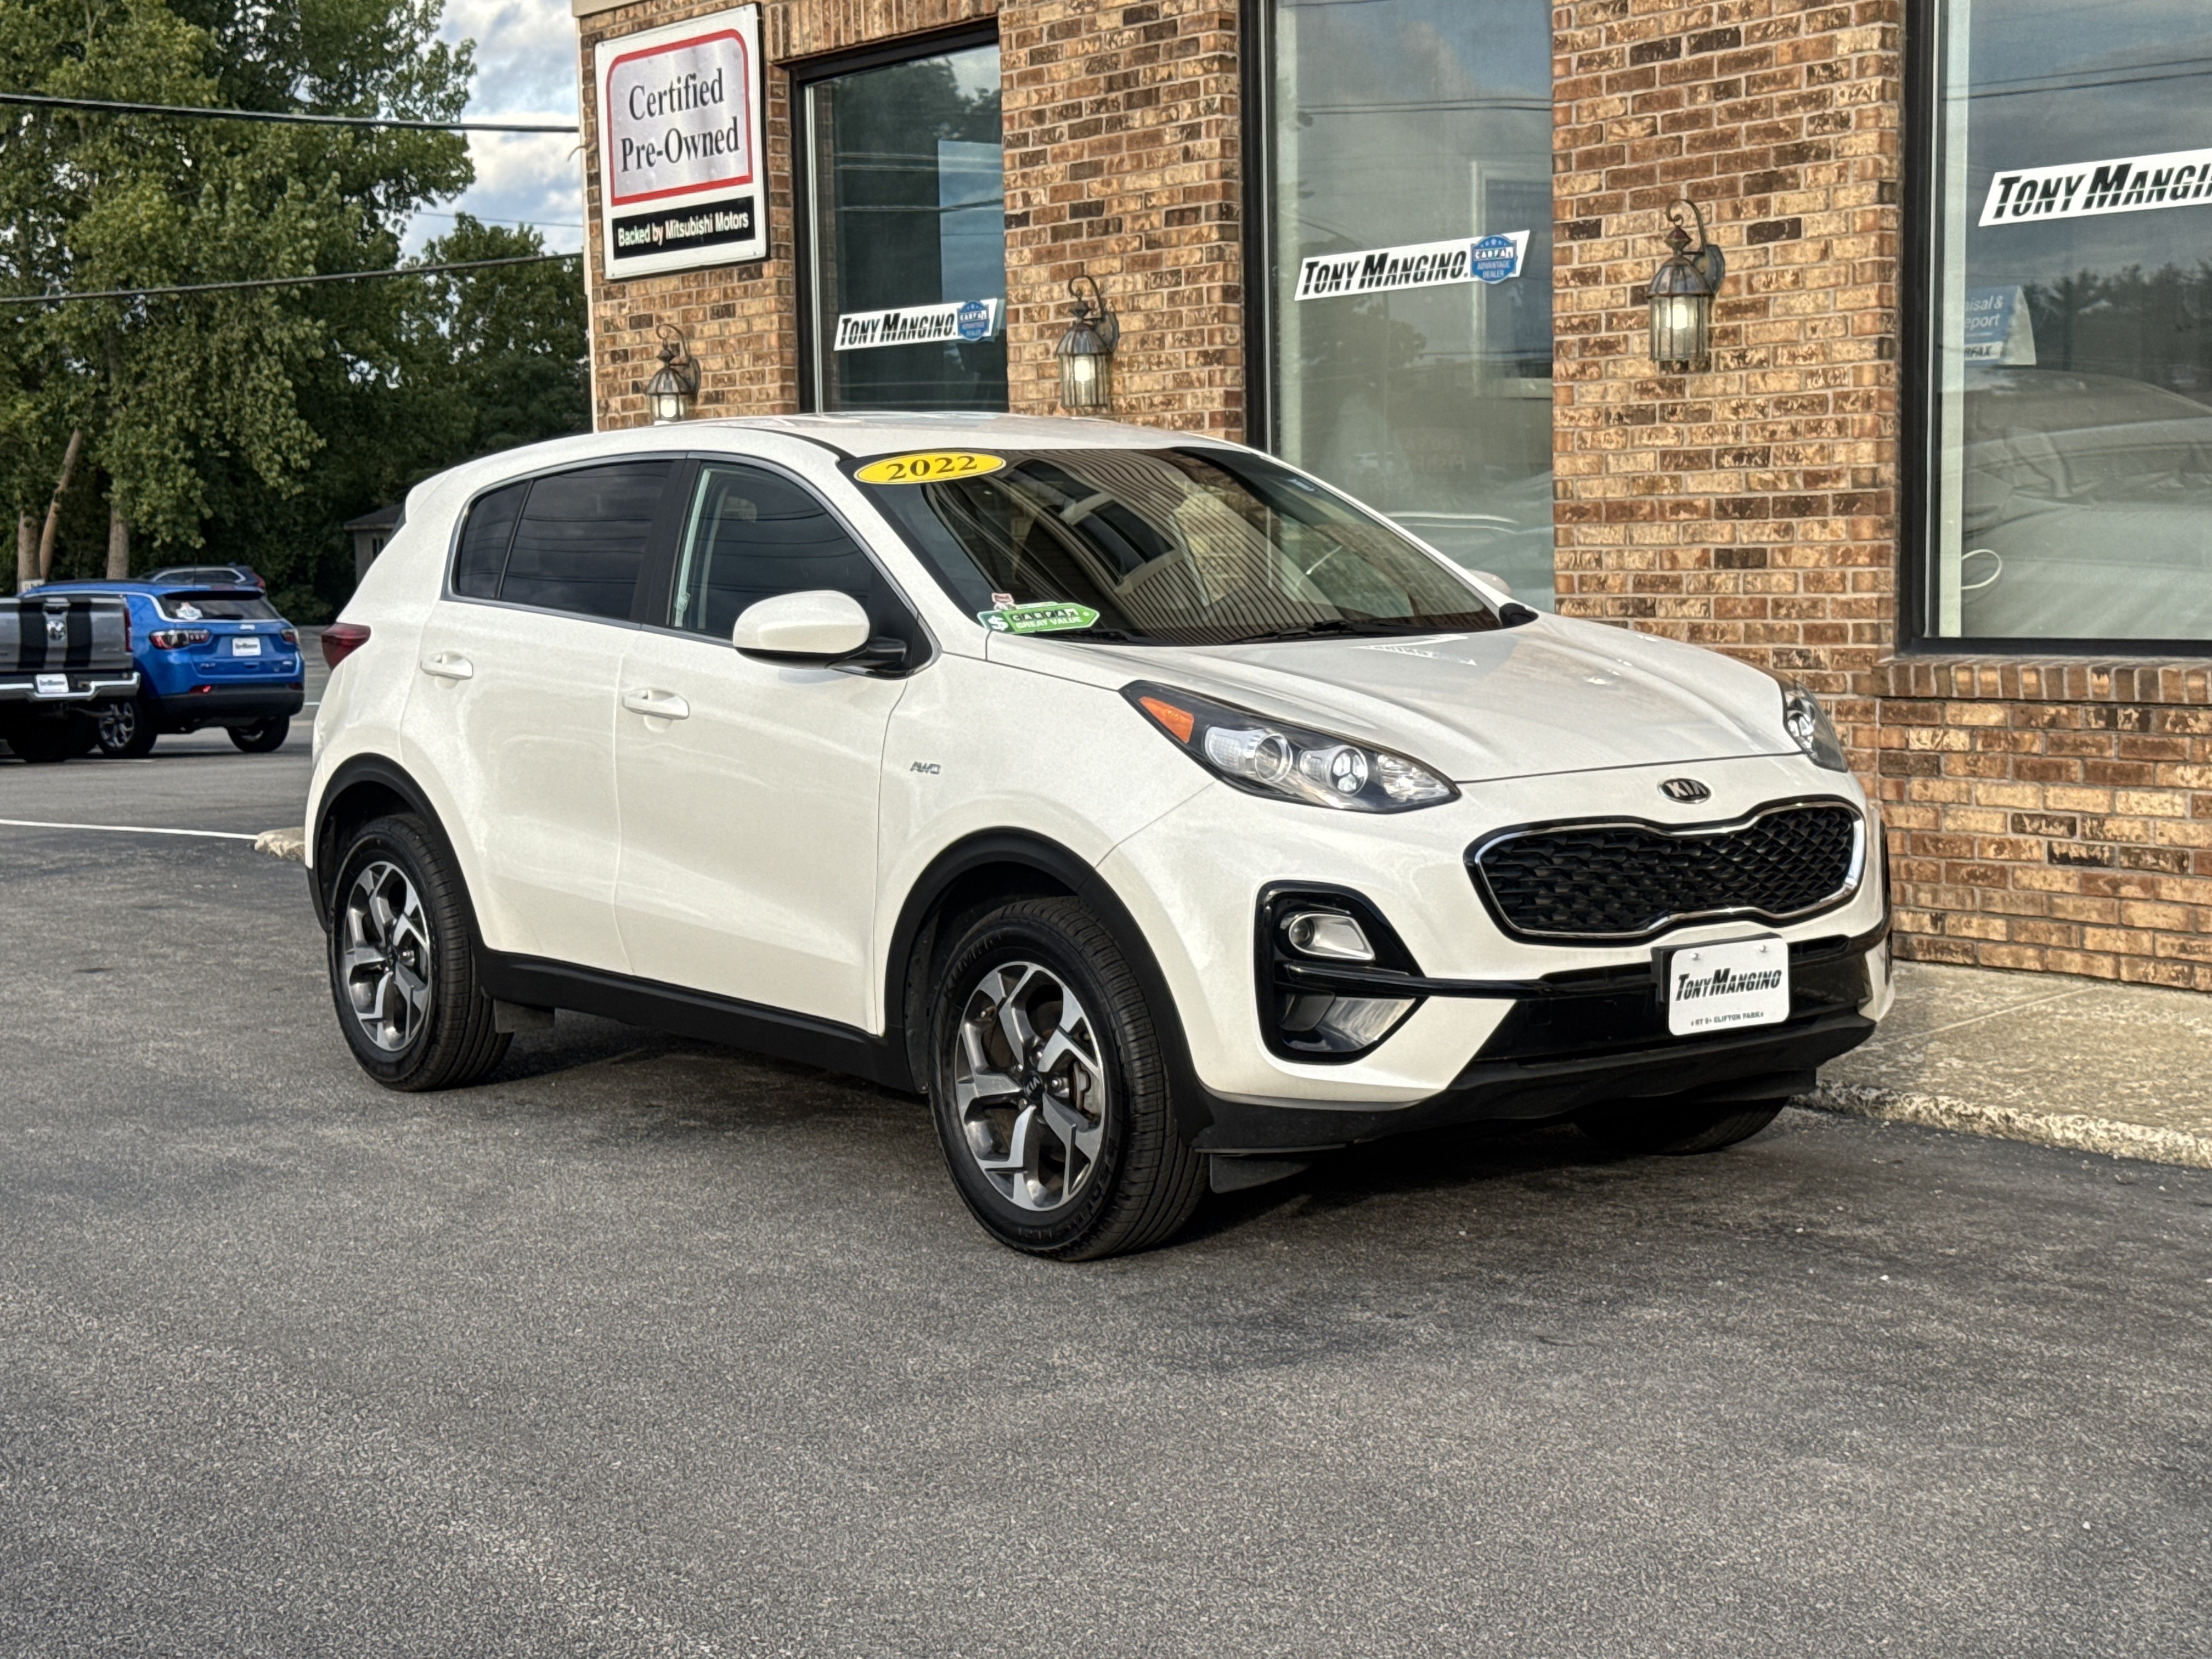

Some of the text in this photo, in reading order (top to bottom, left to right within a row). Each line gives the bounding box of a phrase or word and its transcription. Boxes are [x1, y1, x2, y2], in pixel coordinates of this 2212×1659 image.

[629, 68, 725, 121] Certified
[621, 116, 740, 173] Pre-Owned
[1993, 163, 2212, 219] TONY MANGI
[618, 211, 749, 247] Backed by Mitsubishi Motors
[1302, 261, 1361, 296] TONY
[840, 317, 881, 346] TONY
[885, 455, 978, 481] 2022
[1015, 616, 1084, 629] GREAT VALUE
[1665, 781, 1708, 798] KIA
[1713, 1013, 1741, 1023] CLIFTON
[1742, 1011, 1760, 1020] PARK
